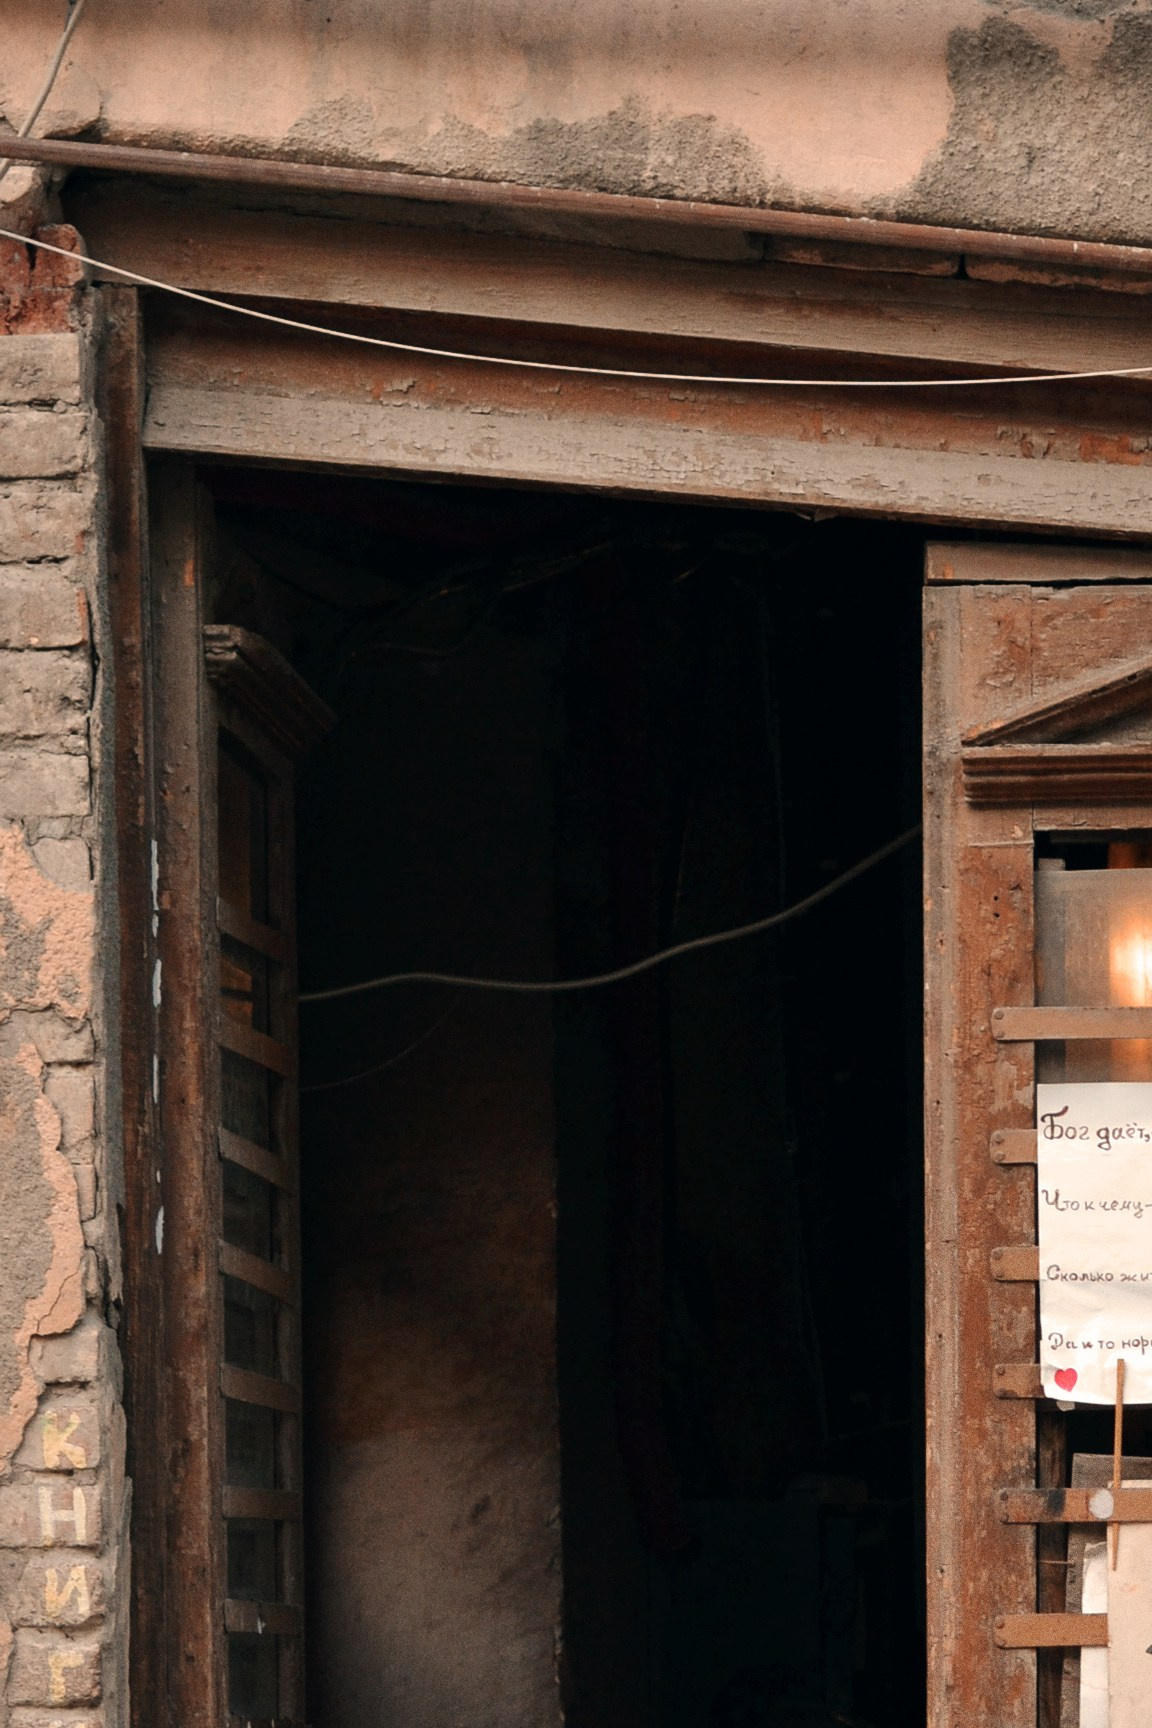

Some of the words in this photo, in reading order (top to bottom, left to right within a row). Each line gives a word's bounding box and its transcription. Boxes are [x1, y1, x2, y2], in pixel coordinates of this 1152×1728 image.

[1040, 1105, 1090, 1140] Бог
[1041, 1189, 1080, 1212] Что
[1046, 1264, 1115, 1282] Сколько
